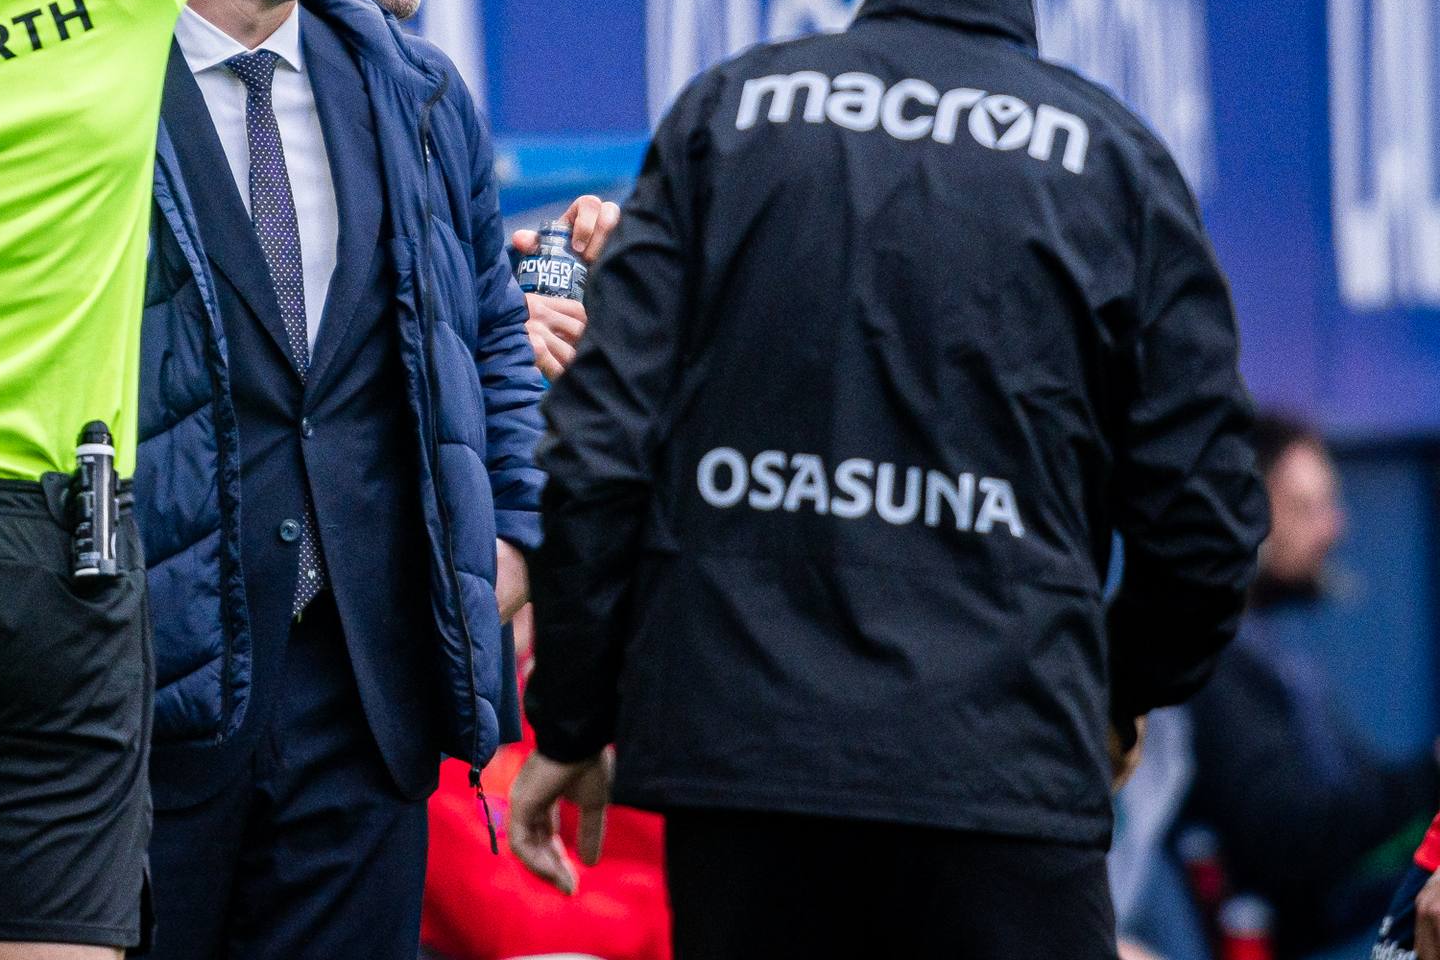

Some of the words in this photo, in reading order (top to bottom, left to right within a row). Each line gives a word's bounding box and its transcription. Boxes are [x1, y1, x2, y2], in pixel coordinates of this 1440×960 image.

[735, 70, 1090, 175] macron
[519, 259, 572, 277] POWER
[539, 272, 570, 289] ADE
[697, 446, 1025, 538] OSASUNA
